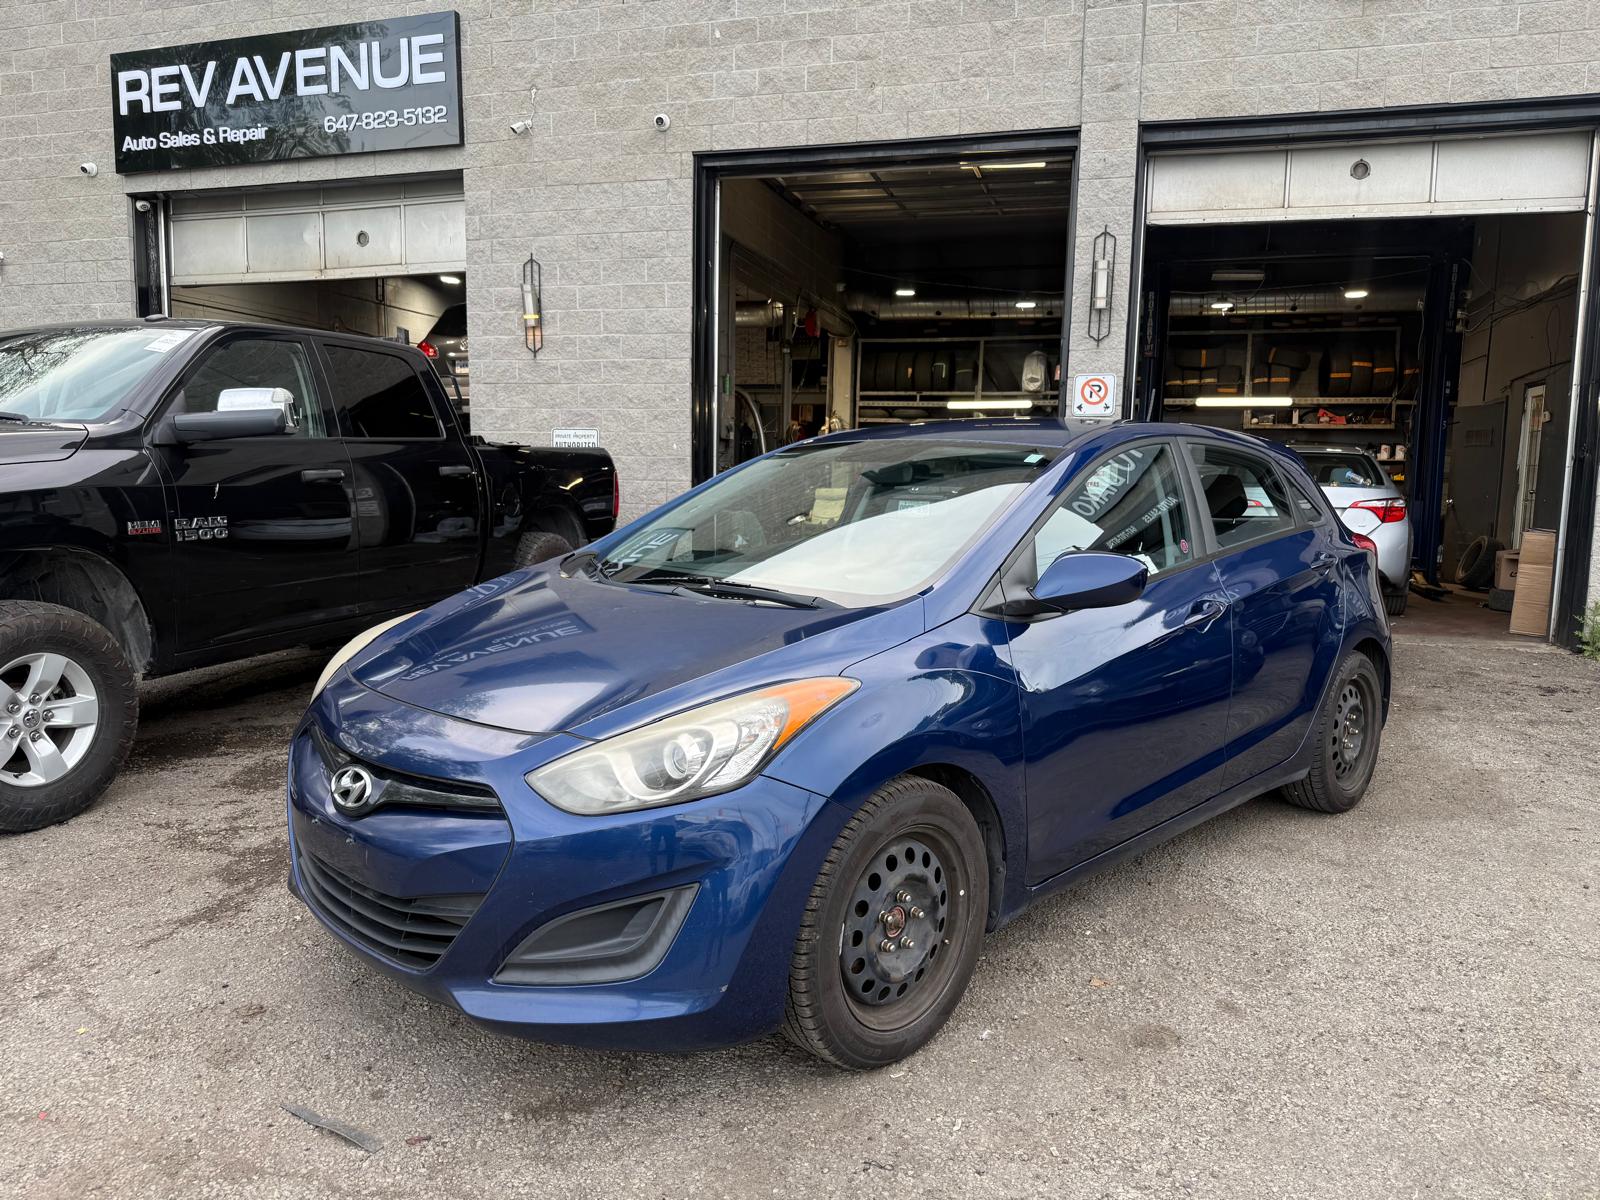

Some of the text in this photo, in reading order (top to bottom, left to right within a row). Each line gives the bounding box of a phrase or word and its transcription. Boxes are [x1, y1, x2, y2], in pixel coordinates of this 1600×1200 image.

[117, 33, 447, 116] REV AVENUE
[323, 105, 448, 134] 647-823-5132
[122, 124, 269, 152] Auto Sales & Repair
[174, 516, 228, 530] RAM
[175, 528, 229, 542] 1500
